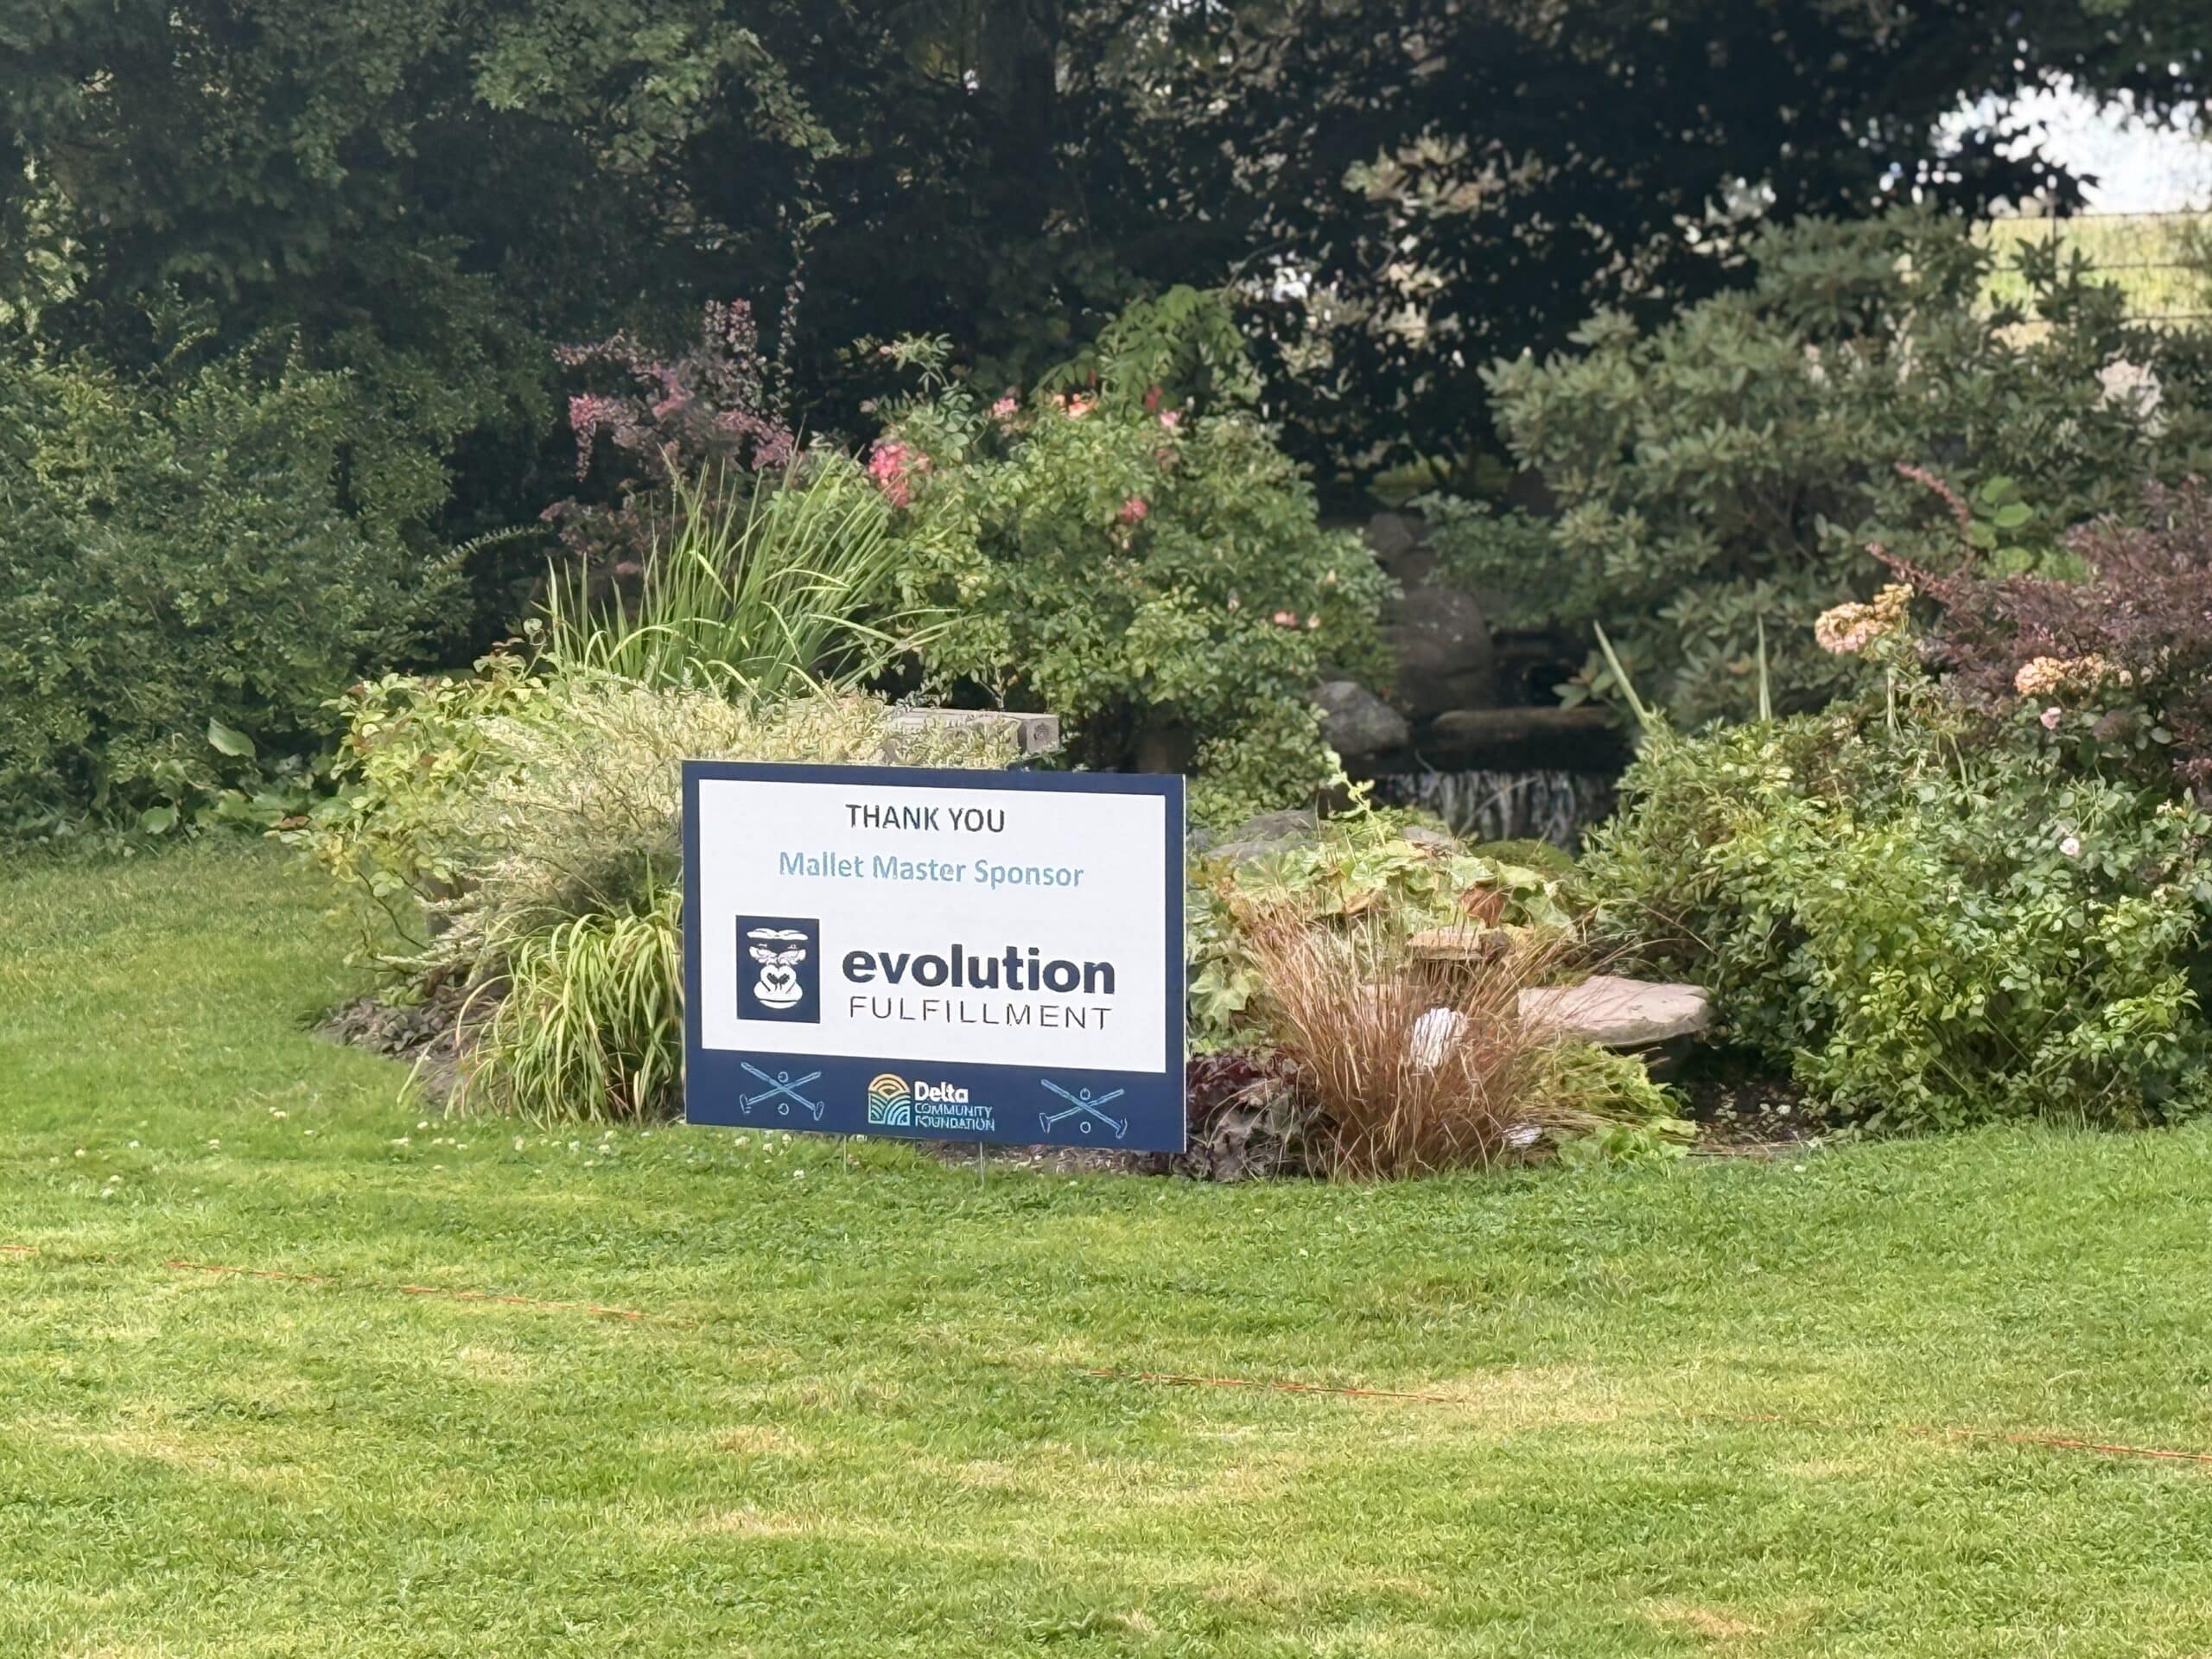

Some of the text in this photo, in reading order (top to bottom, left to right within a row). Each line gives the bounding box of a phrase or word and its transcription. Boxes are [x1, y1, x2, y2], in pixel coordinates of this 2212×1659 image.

[846, 804, 1006, 833] THANK YOU
[779, 851, 1084, 889] Mallet Master Sponsor
[842, 944, 1116, 995] evolution
[849, 995, 1113, 1030] FULFILLMENT
[914, 1081, 969, 1103] Delta
[914, 1103, 993, 1118] COMMUNITY
[915, 1115, 995, 1131] FOUNDATION
